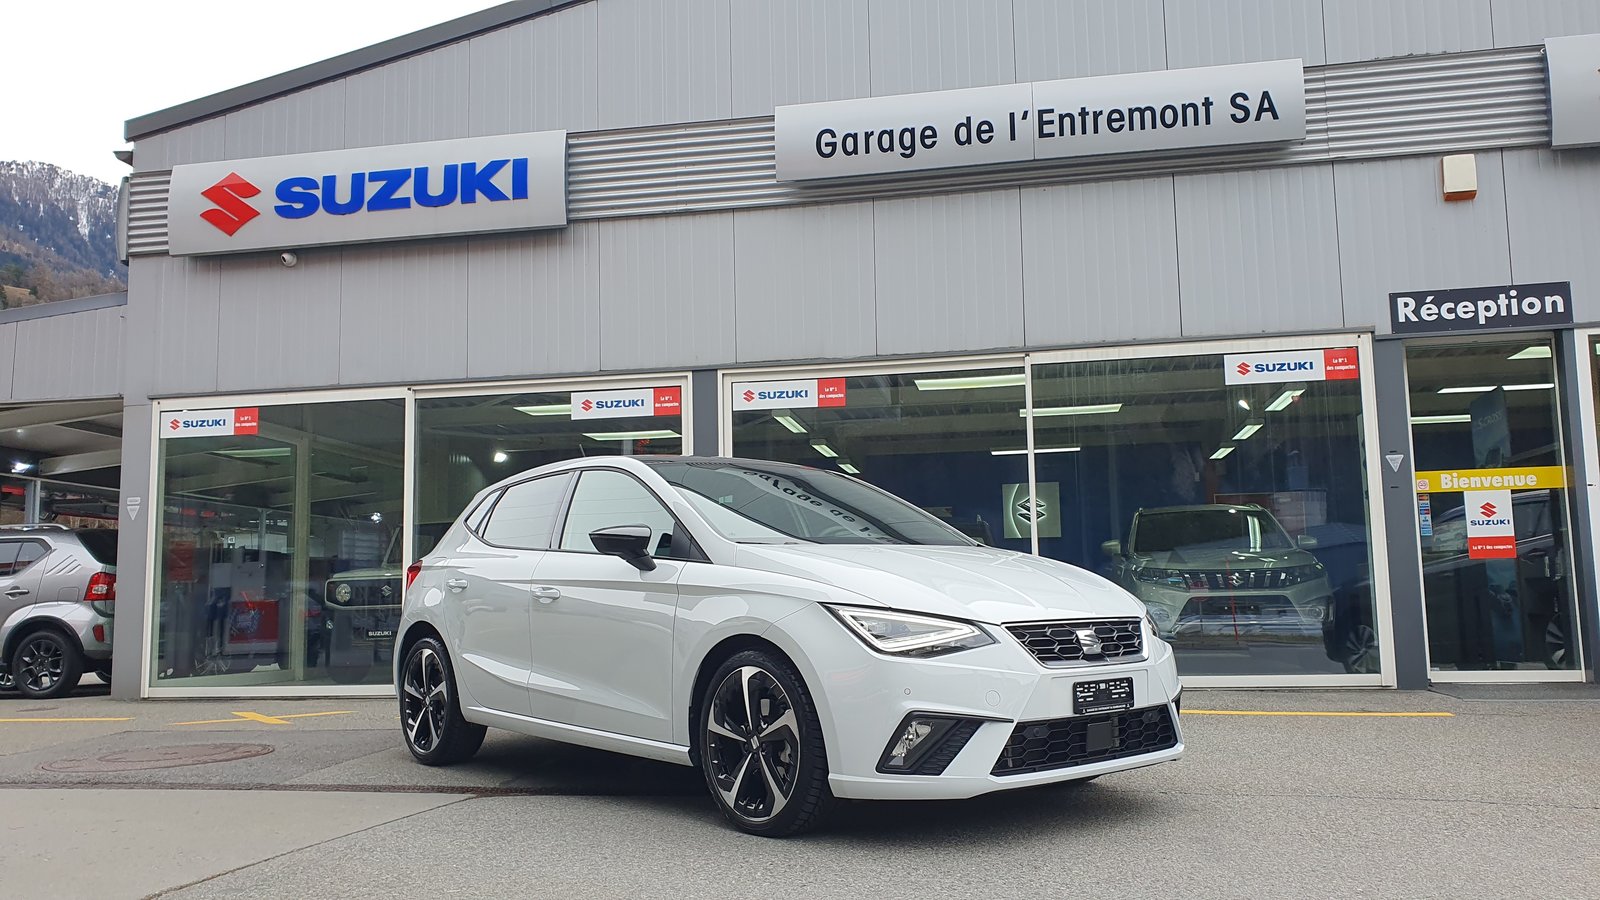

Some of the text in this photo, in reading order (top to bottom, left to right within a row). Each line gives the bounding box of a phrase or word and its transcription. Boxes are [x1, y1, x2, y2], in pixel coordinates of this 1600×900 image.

[815, 90, 1280, 159] Garage de l'Entremont SA
[274, 157, 529, 220] SUZUKI
[1396, 289, 1565, 325] Réception
[1254, 361, 1314, 373] SUZUKI
[758, 389, 808, 400] SUZUKI
[595, 399, 645, 409] SUZUKI
[182, 419, 226, 428] SUZUKI
[1440, 472, 1538, 489] Bienvenue
[1470, 518, 1511, 526] SUZUKI
